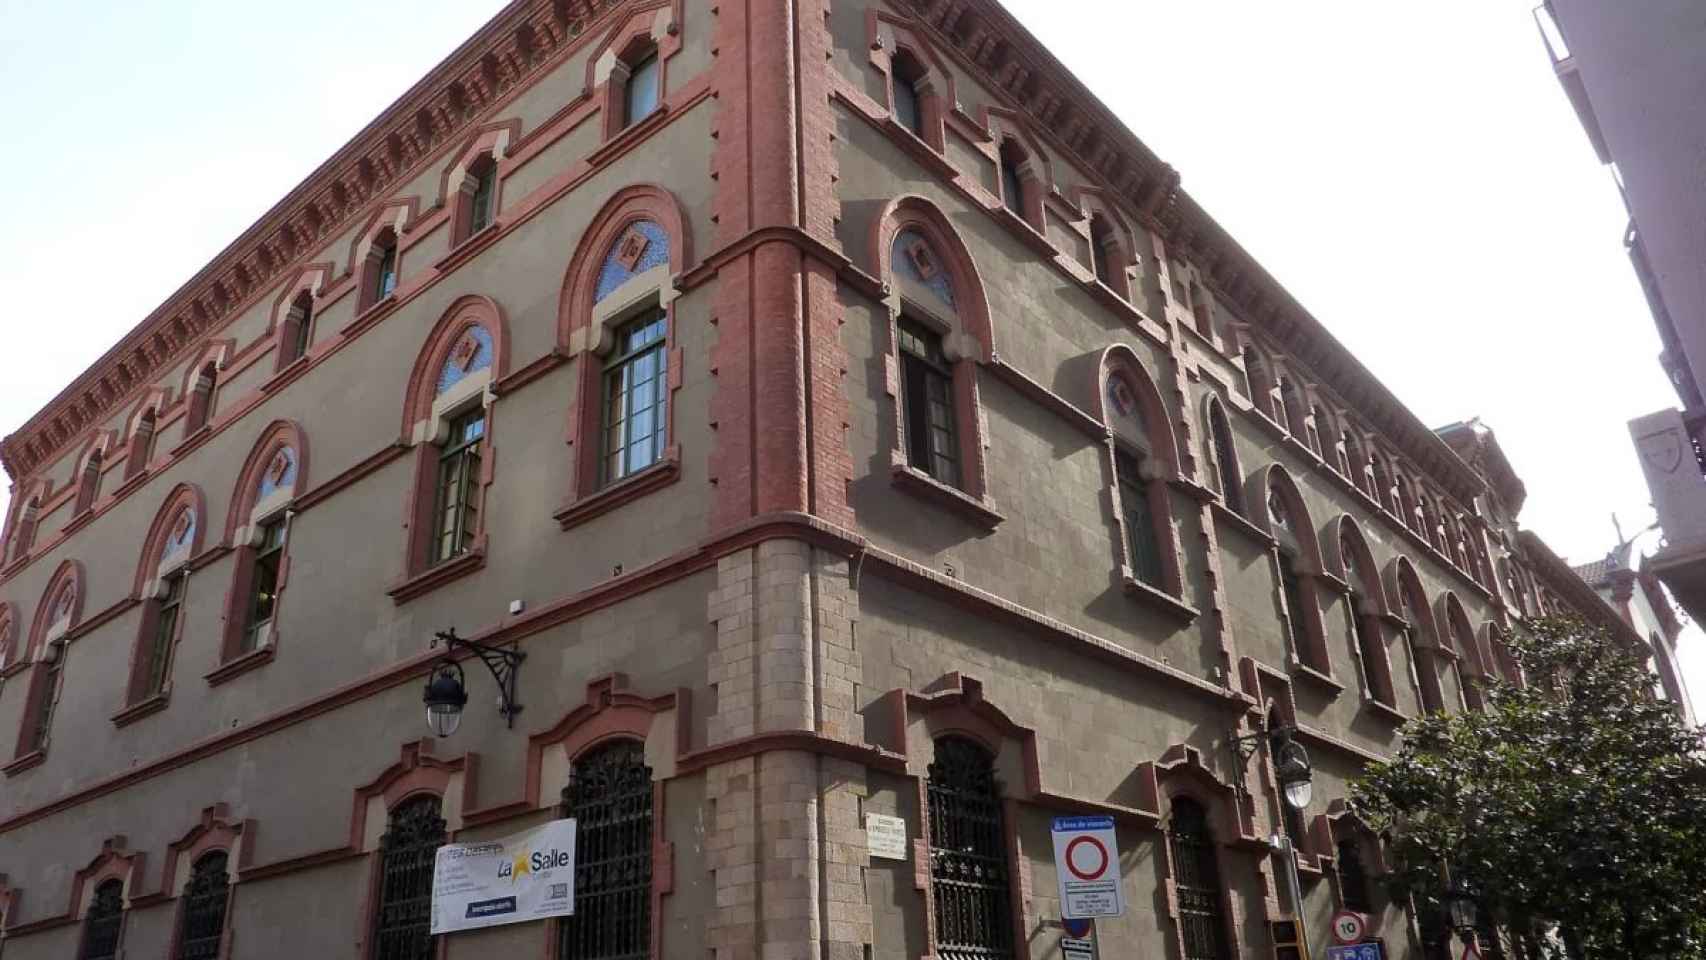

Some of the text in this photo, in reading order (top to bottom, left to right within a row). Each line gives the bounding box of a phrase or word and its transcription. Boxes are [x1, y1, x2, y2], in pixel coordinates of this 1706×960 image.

[497, 849, 569, 878] La Salle
[1340, 922, 1356, 934] 10
